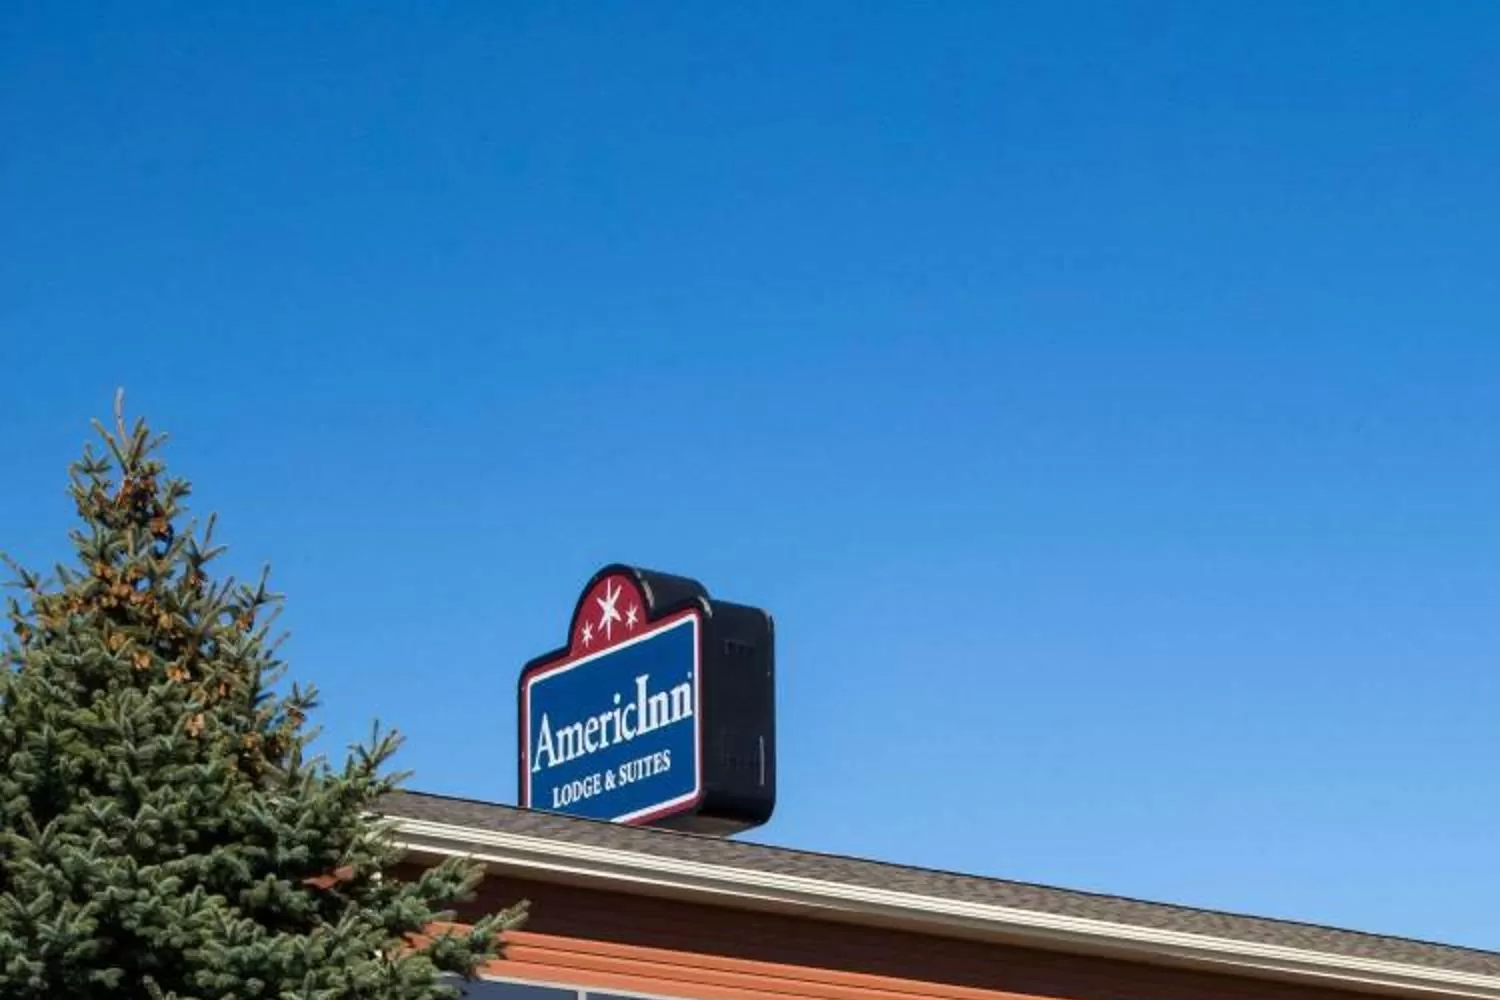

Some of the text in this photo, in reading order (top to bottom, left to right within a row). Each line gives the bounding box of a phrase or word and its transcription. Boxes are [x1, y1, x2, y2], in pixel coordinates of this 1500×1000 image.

[532, 674, 693, 772] AmericInn
[553, 750, 671, 808] LODGE & SUITES
